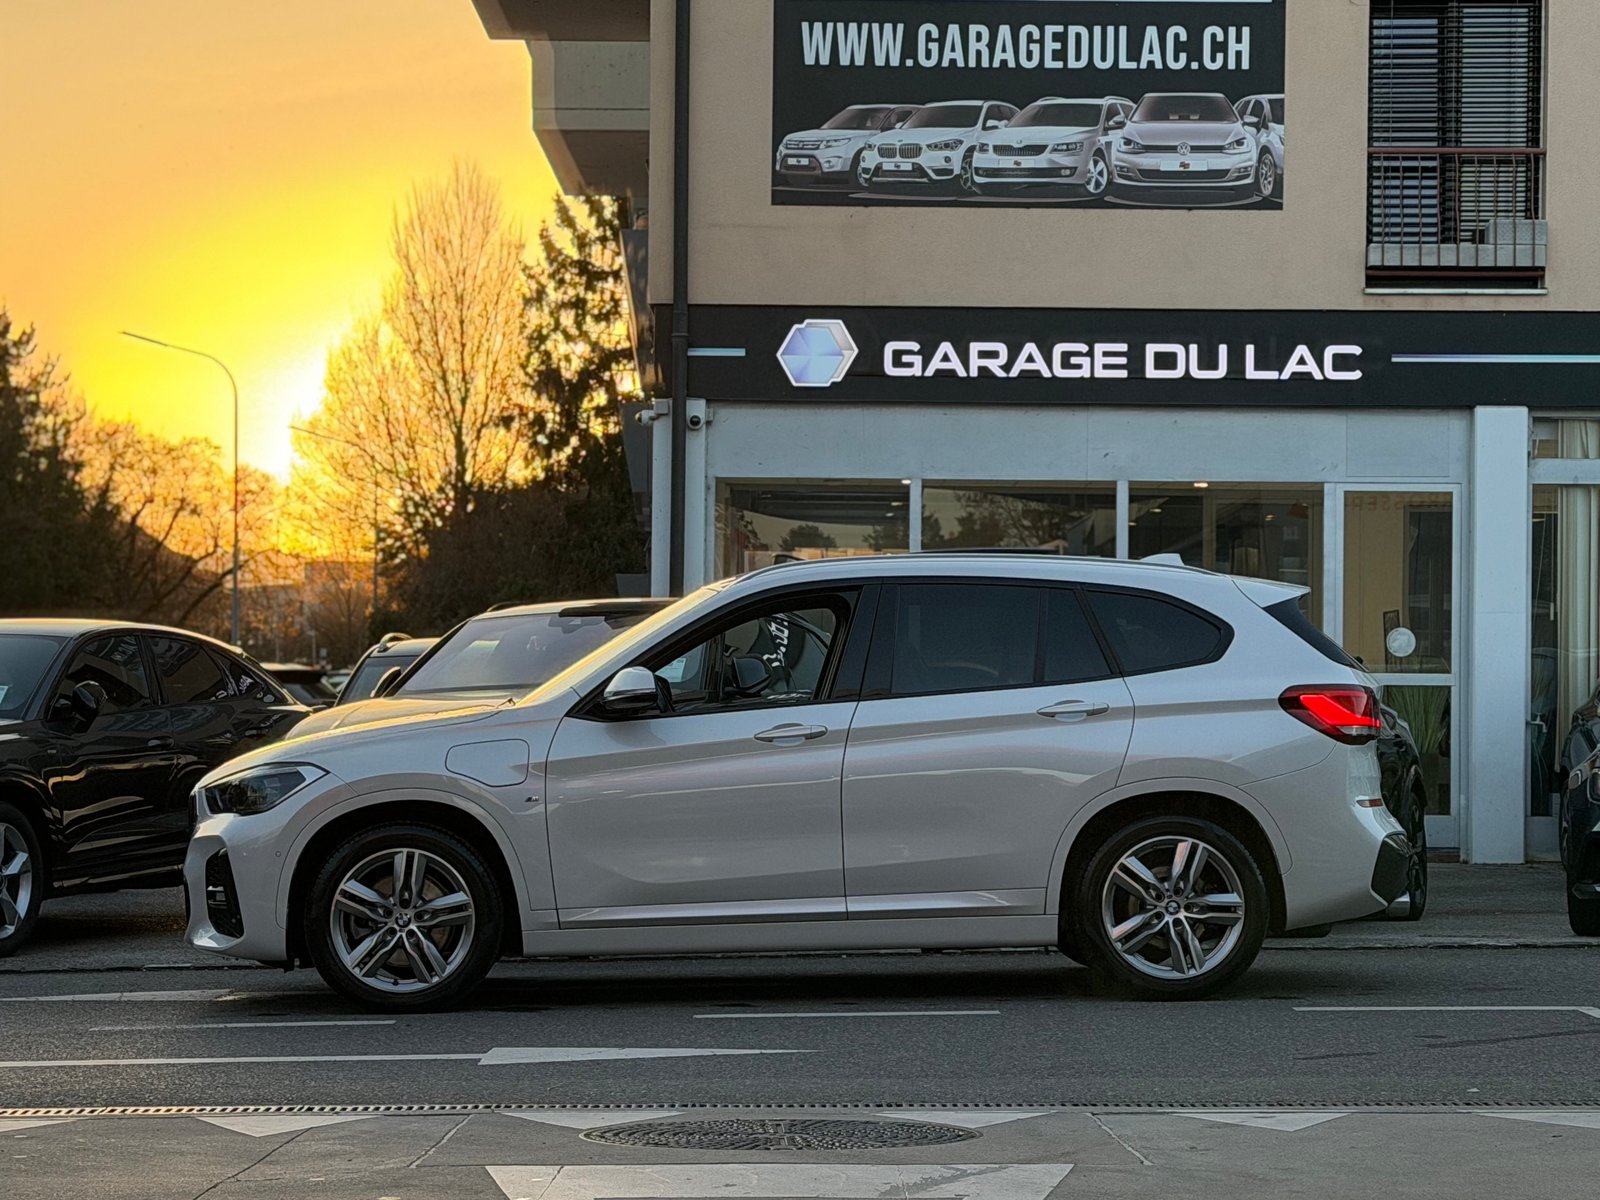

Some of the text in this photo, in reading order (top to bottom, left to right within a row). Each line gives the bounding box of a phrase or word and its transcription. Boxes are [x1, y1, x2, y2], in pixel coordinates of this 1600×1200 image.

[801, 21, 1250, 71] WWW.GARAGEDULAC.CH
[883, 341, 1363, 382] GARAGE DU LAC
